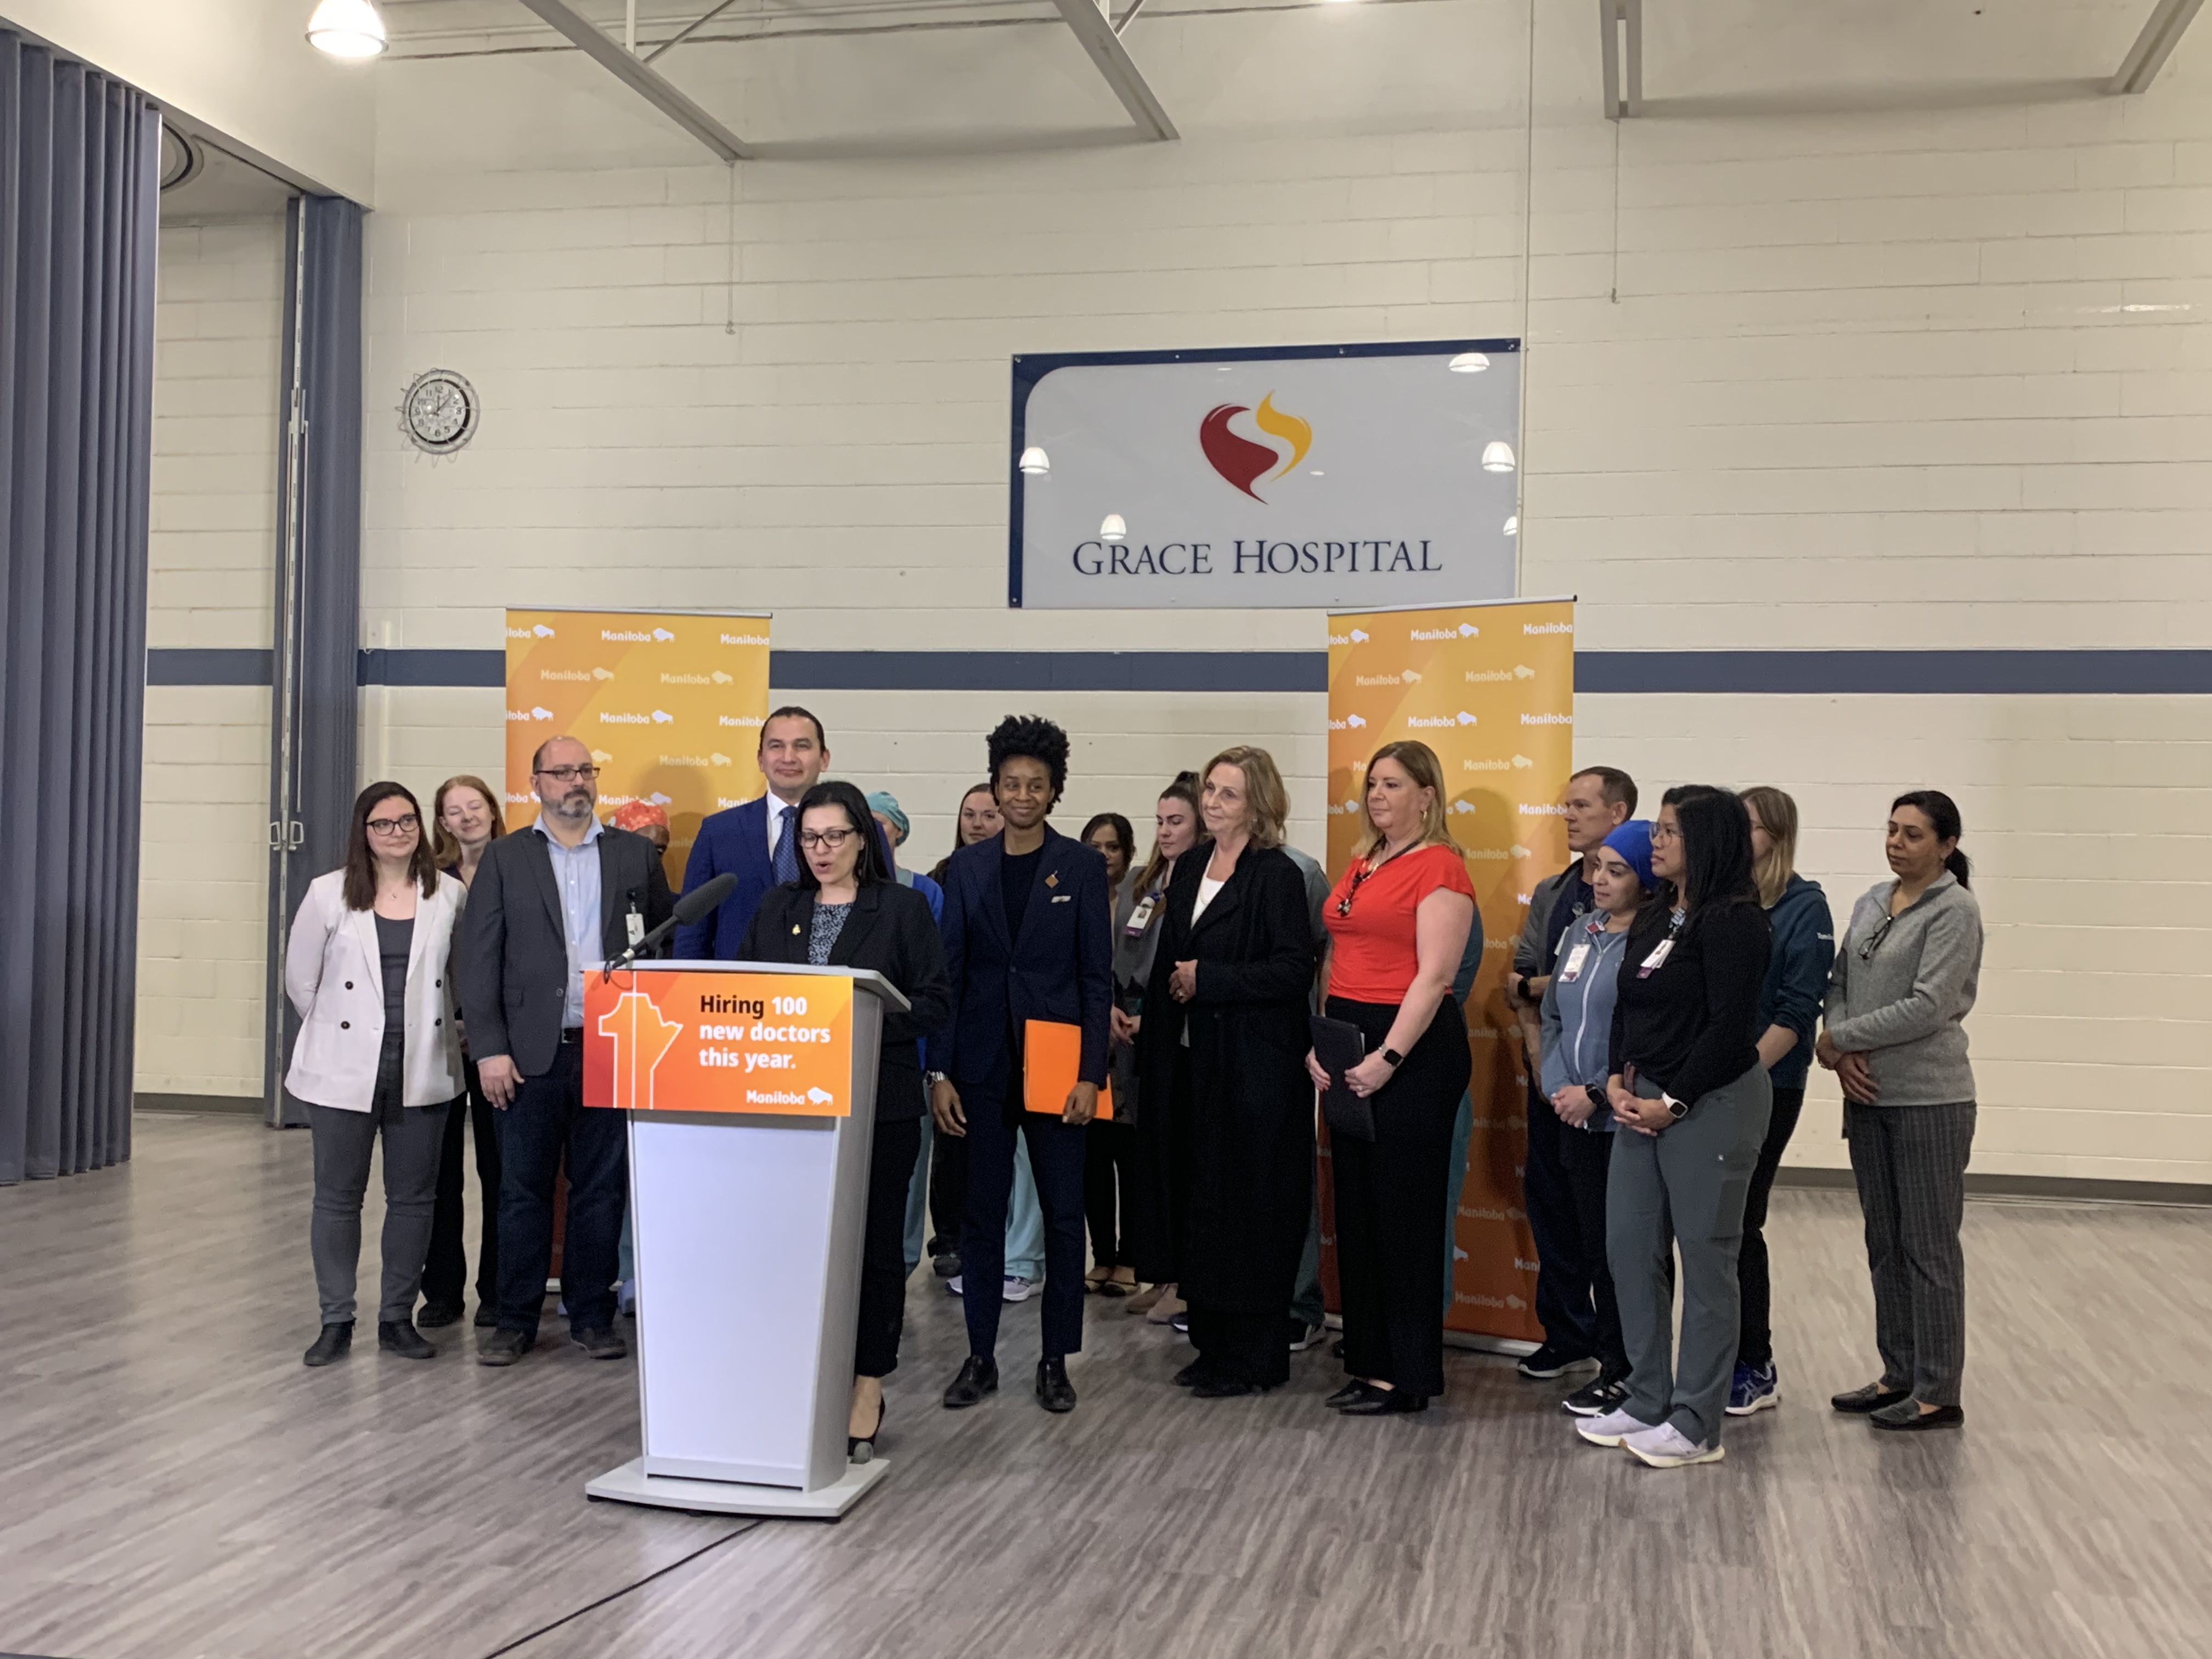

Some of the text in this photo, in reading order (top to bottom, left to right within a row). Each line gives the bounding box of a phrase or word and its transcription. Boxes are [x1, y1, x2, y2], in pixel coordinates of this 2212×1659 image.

[1073, 540, 1442, 575] GRACE HOSPITAL
[1410, 628, 1457, 641] Manitoba
[1523, 623, 1573, 635] Manitoba
[602, 630, 651, 642] Manitoba
[720, 633, 769, 646] Manitoba
[541, 669, 590, 681] Manitoba
[661, 673, 710, 685] Manitoba
[1356, 674, 1400, 686] Manitoba
[1465, 669, 1512, 682] Manitoba
[600, 712, 650, 724] Manitoba
[1408, 715, 1455, 728] Manitoba
[1521, 713, 1572, 725] Manitoba
[659, 754, 708, 766] Manitoba
[1464, 758, 1510, 771] Manitoba
[700, 995, 807, 1020] Hiring 100
[699, 1022, 831, 1043] new doctors
[699, 1047, 797, 1073] this year.
[746, 1089, 805, 1105] Manitoba
